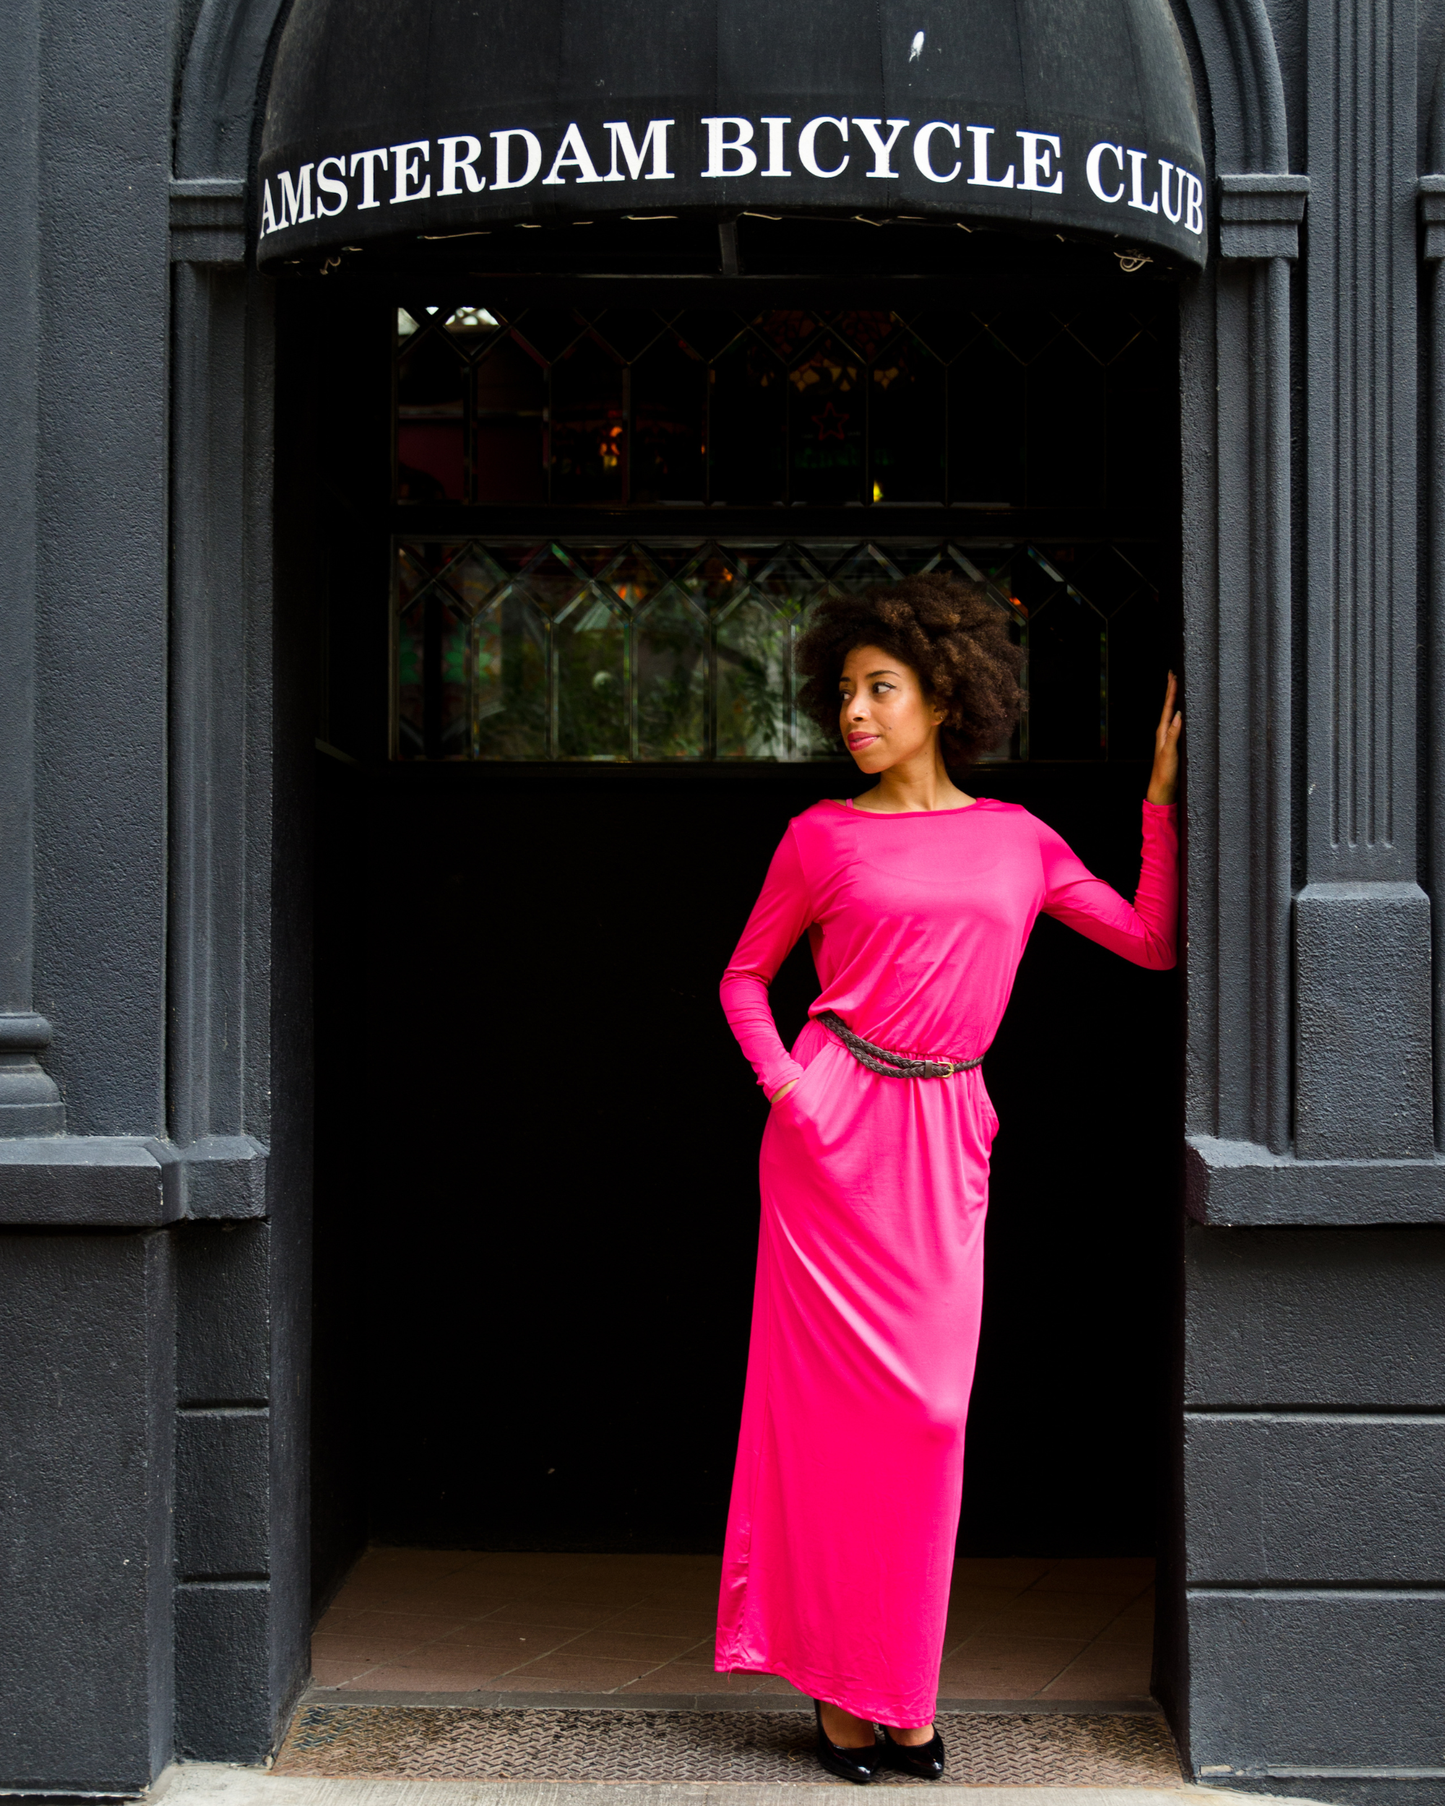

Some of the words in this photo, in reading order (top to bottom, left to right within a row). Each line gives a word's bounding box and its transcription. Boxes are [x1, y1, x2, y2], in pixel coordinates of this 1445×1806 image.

[259, 119, 676, 240] AMSTERDAM
[701, 116, 1063, 195] BICYCLE
[1085, 142, 1204, 235] CLUB
